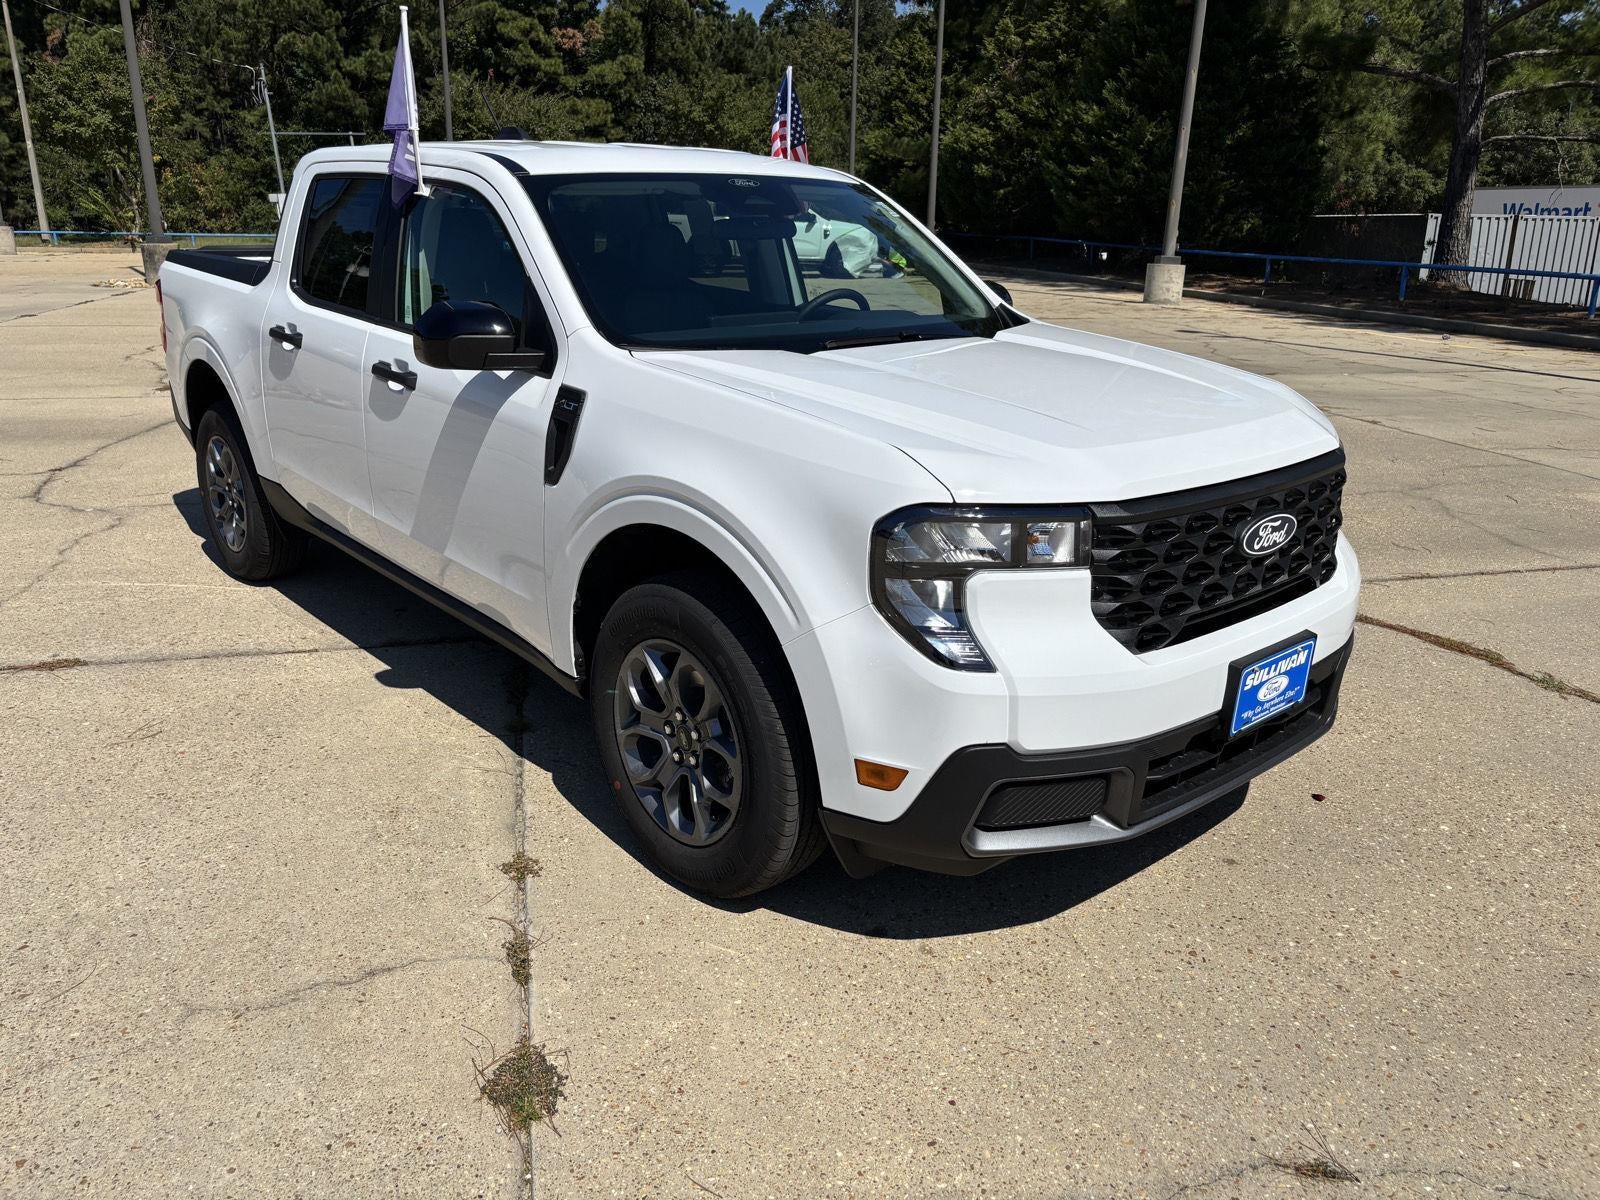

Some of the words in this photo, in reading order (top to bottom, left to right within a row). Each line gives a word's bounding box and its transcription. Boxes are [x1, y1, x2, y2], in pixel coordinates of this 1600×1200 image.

[1503, 202, 1592, 216] Walmart
[1254, 520, 1288, 550] Ford
[1243, 650, 1309, 691] SULLIVAN
